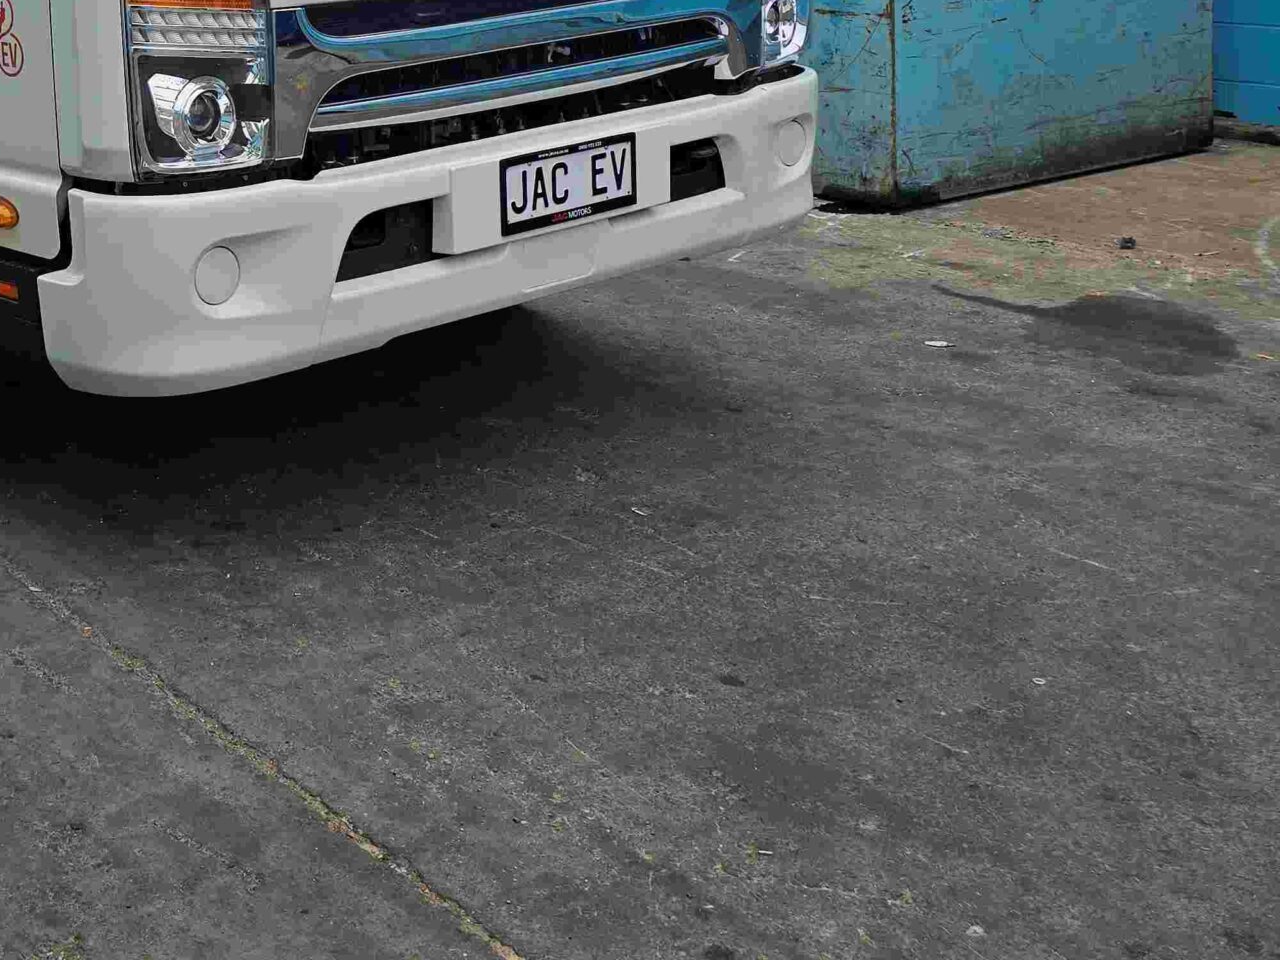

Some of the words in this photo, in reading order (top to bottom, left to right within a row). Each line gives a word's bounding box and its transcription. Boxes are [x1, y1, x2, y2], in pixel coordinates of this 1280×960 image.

[1, 41, 18, 68] EV
[511, 161, 569, 214] JAC
[591, 148, 627, 196] EV
[568, 206, 592, 219] MOTORS
